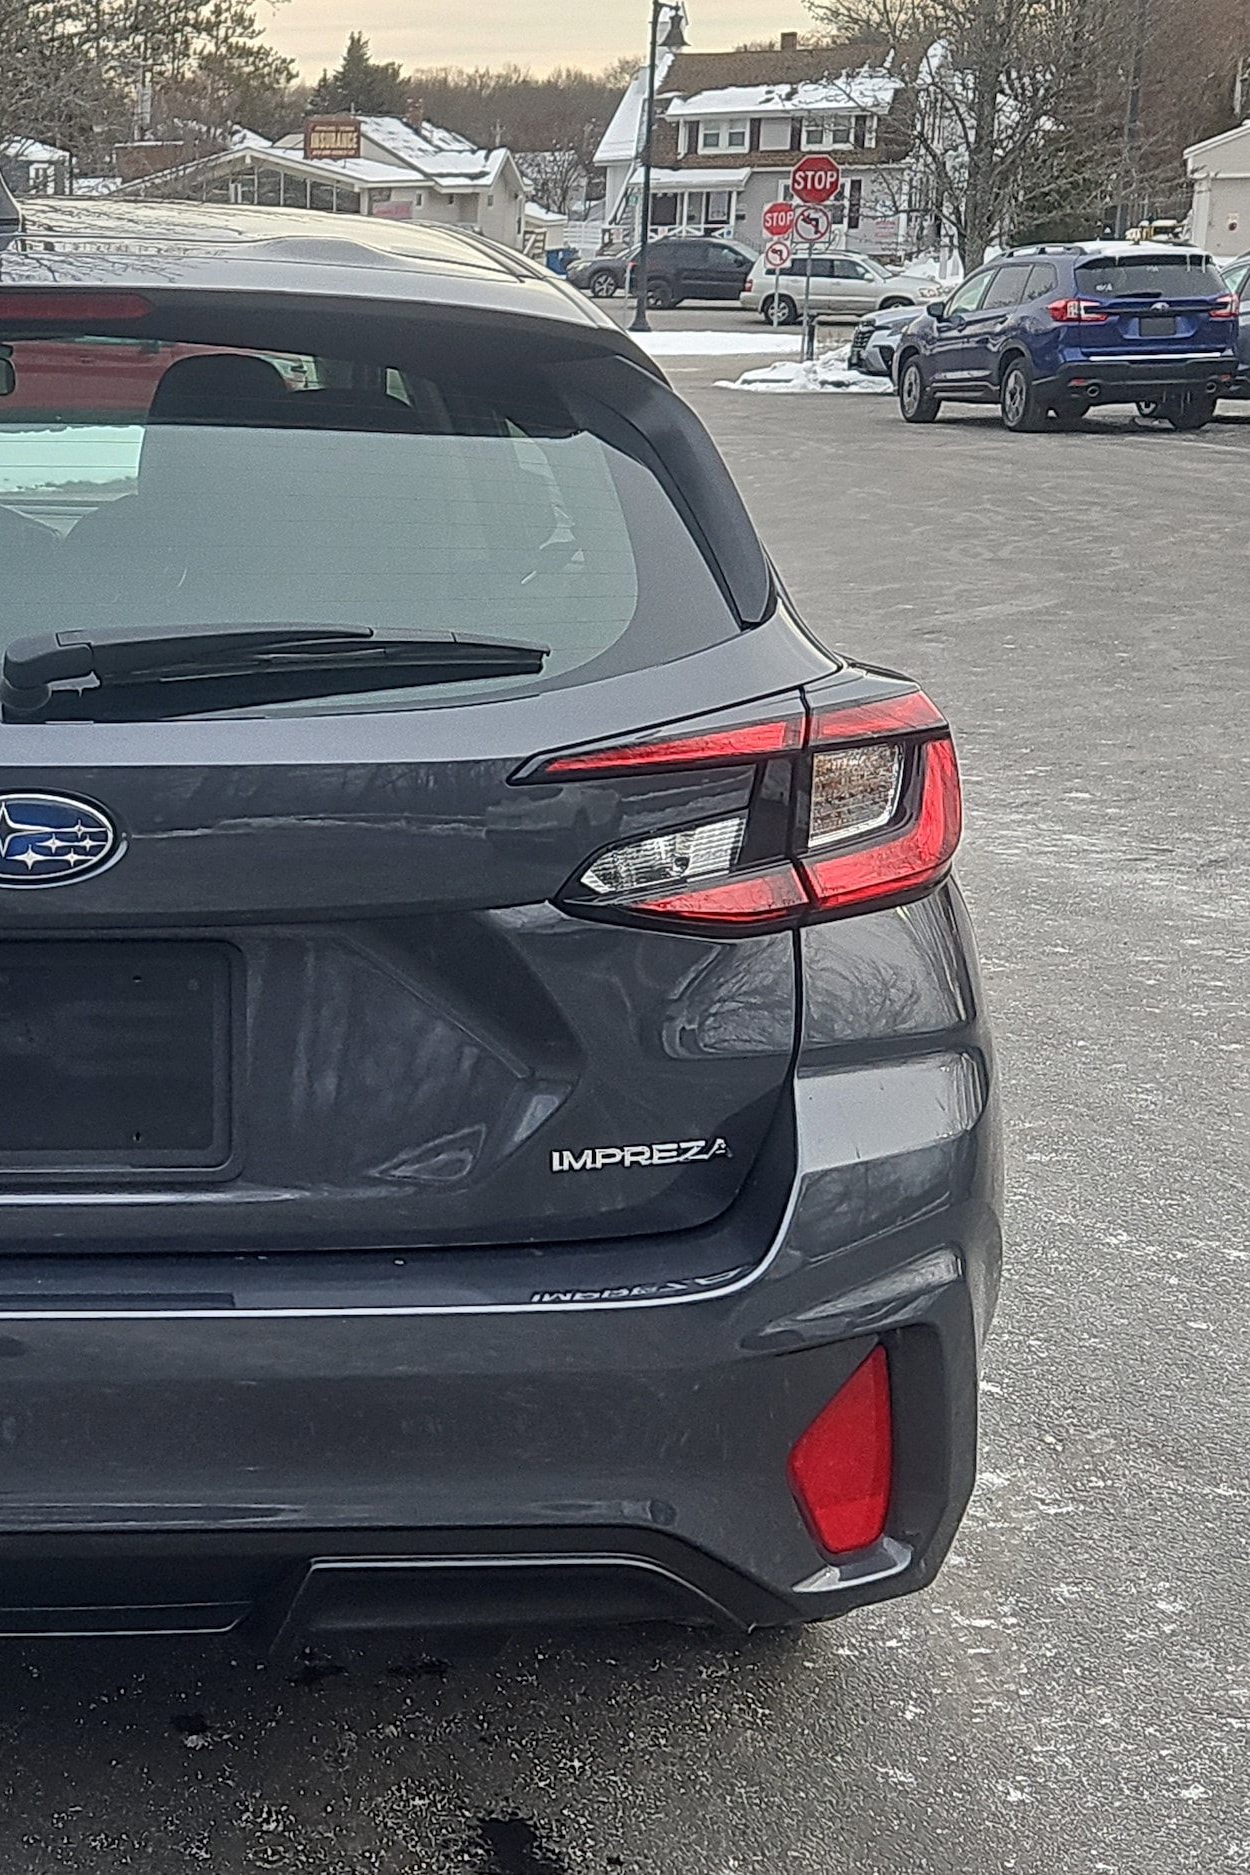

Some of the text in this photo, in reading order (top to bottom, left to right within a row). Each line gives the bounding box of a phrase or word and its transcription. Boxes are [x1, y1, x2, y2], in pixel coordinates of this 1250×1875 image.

[794, 170, 837, 190] STOP
[764, 211, 793, 227] STOP
[551, 1138, 733, 1172] IMPREZA
